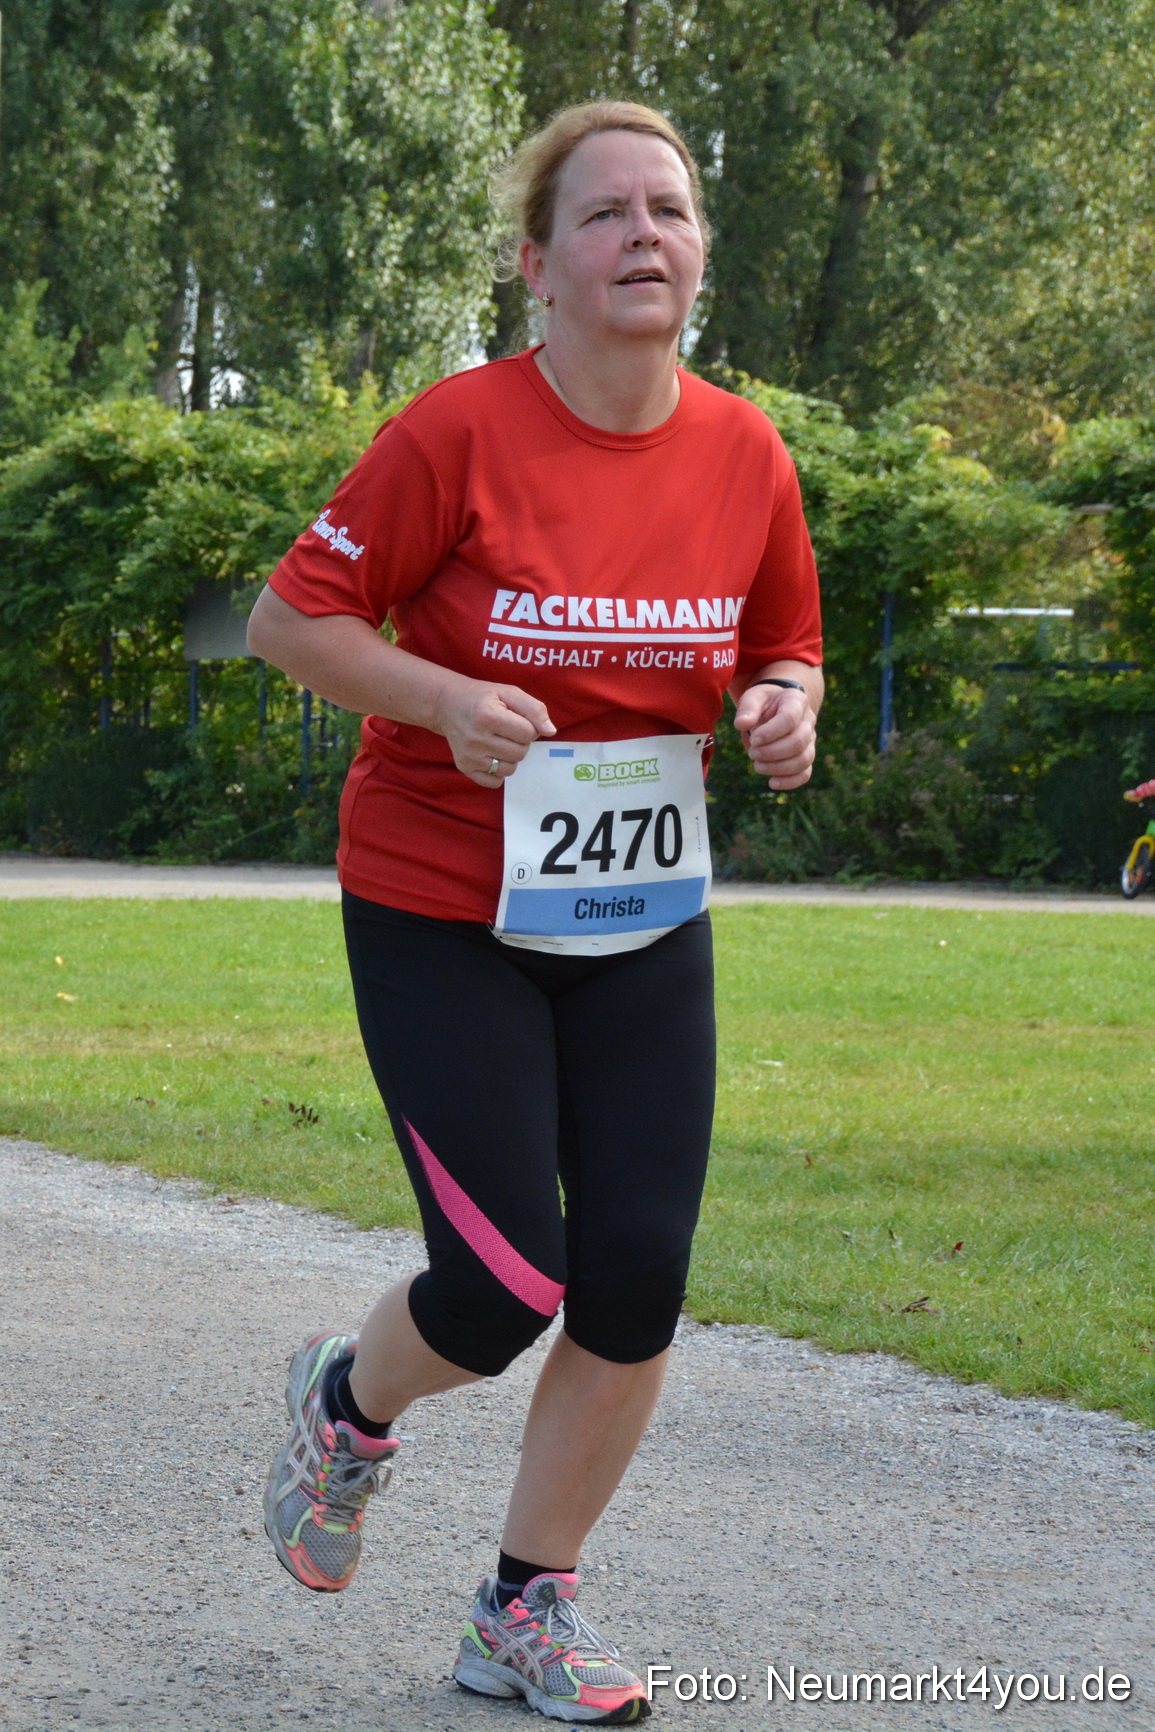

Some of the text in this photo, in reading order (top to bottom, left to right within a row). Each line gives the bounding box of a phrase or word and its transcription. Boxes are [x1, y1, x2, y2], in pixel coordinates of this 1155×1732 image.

[490, 588, 743, 629] FACKELMANN
[482, 639, 736, 669] HAUSHALT KÜCHE BAD
[598, 758, 660, 781] BOCK
[539, 803, 683, 875] 2470
[517, 868, 526, 880] D
[573, 895, 646, 921] Christa
